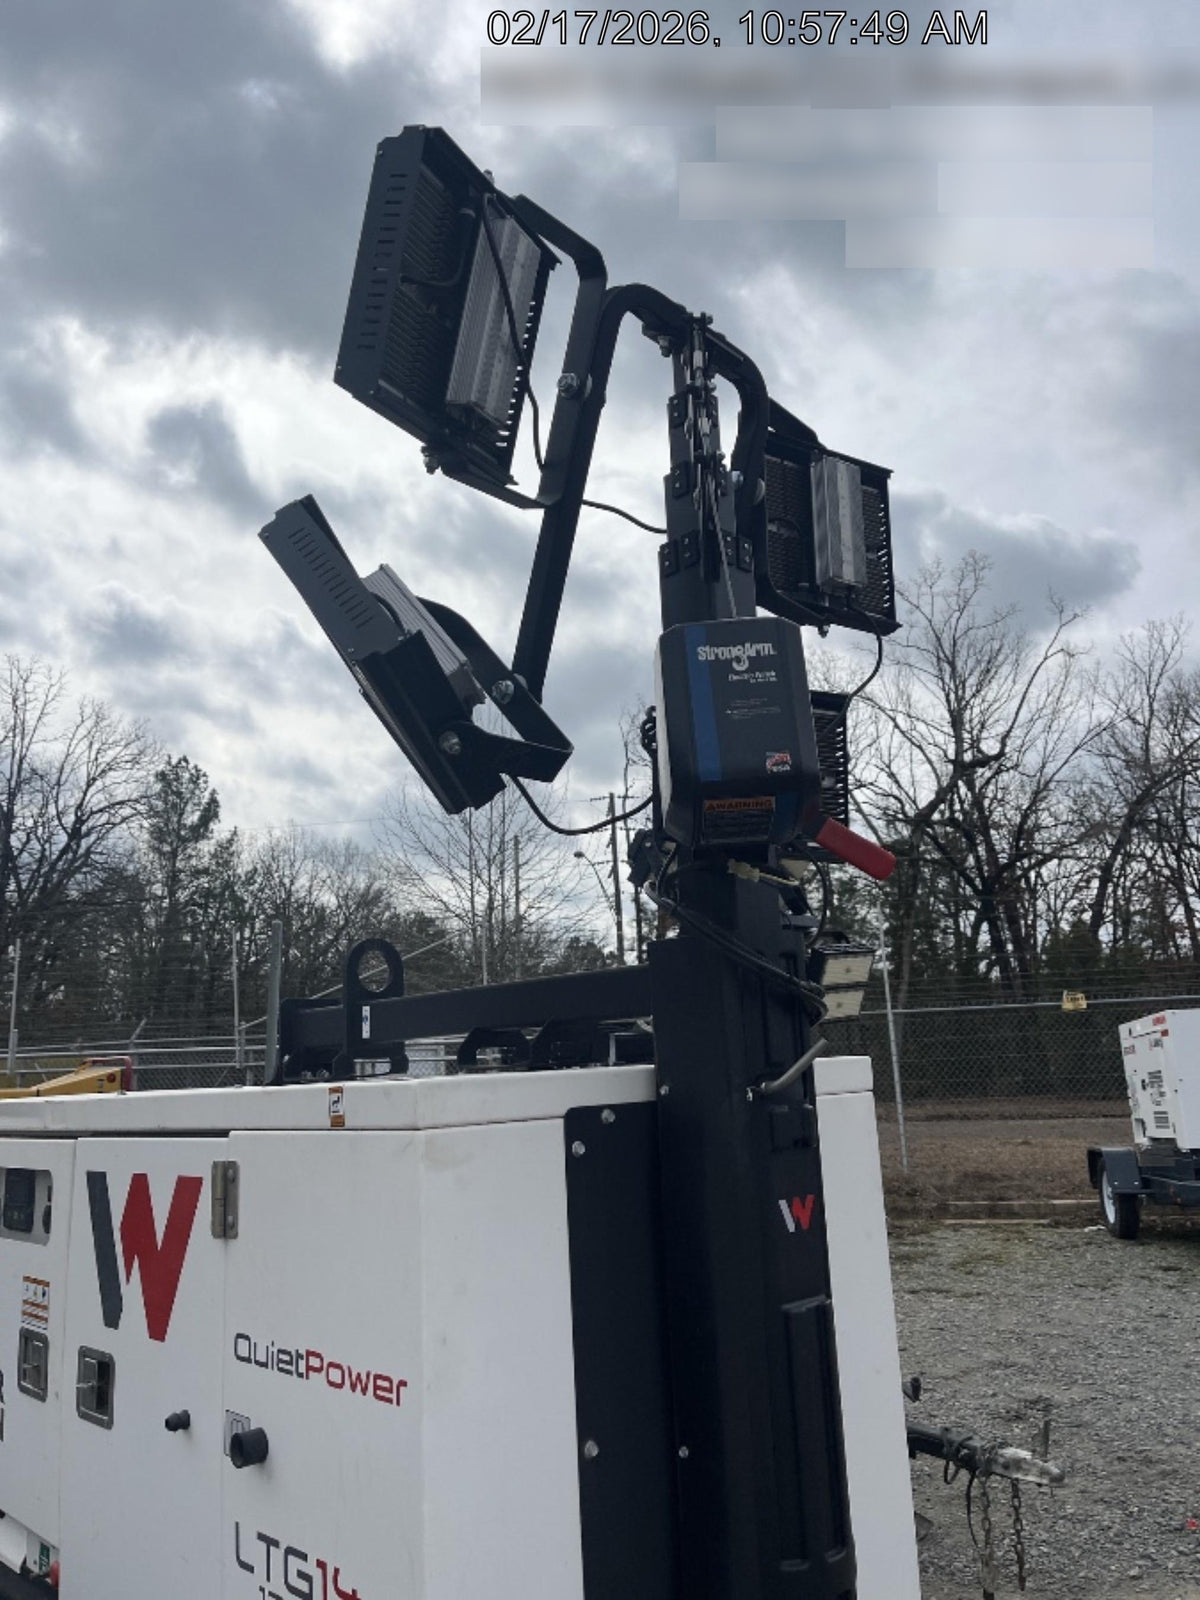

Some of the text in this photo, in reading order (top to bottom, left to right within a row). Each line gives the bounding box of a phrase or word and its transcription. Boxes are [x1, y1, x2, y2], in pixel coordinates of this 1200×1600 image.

[697, 642, 774, 671] StrongArm
[715, 799, 773, 812] WARNING
[234, 1332, 408, 1406] QuietPower
